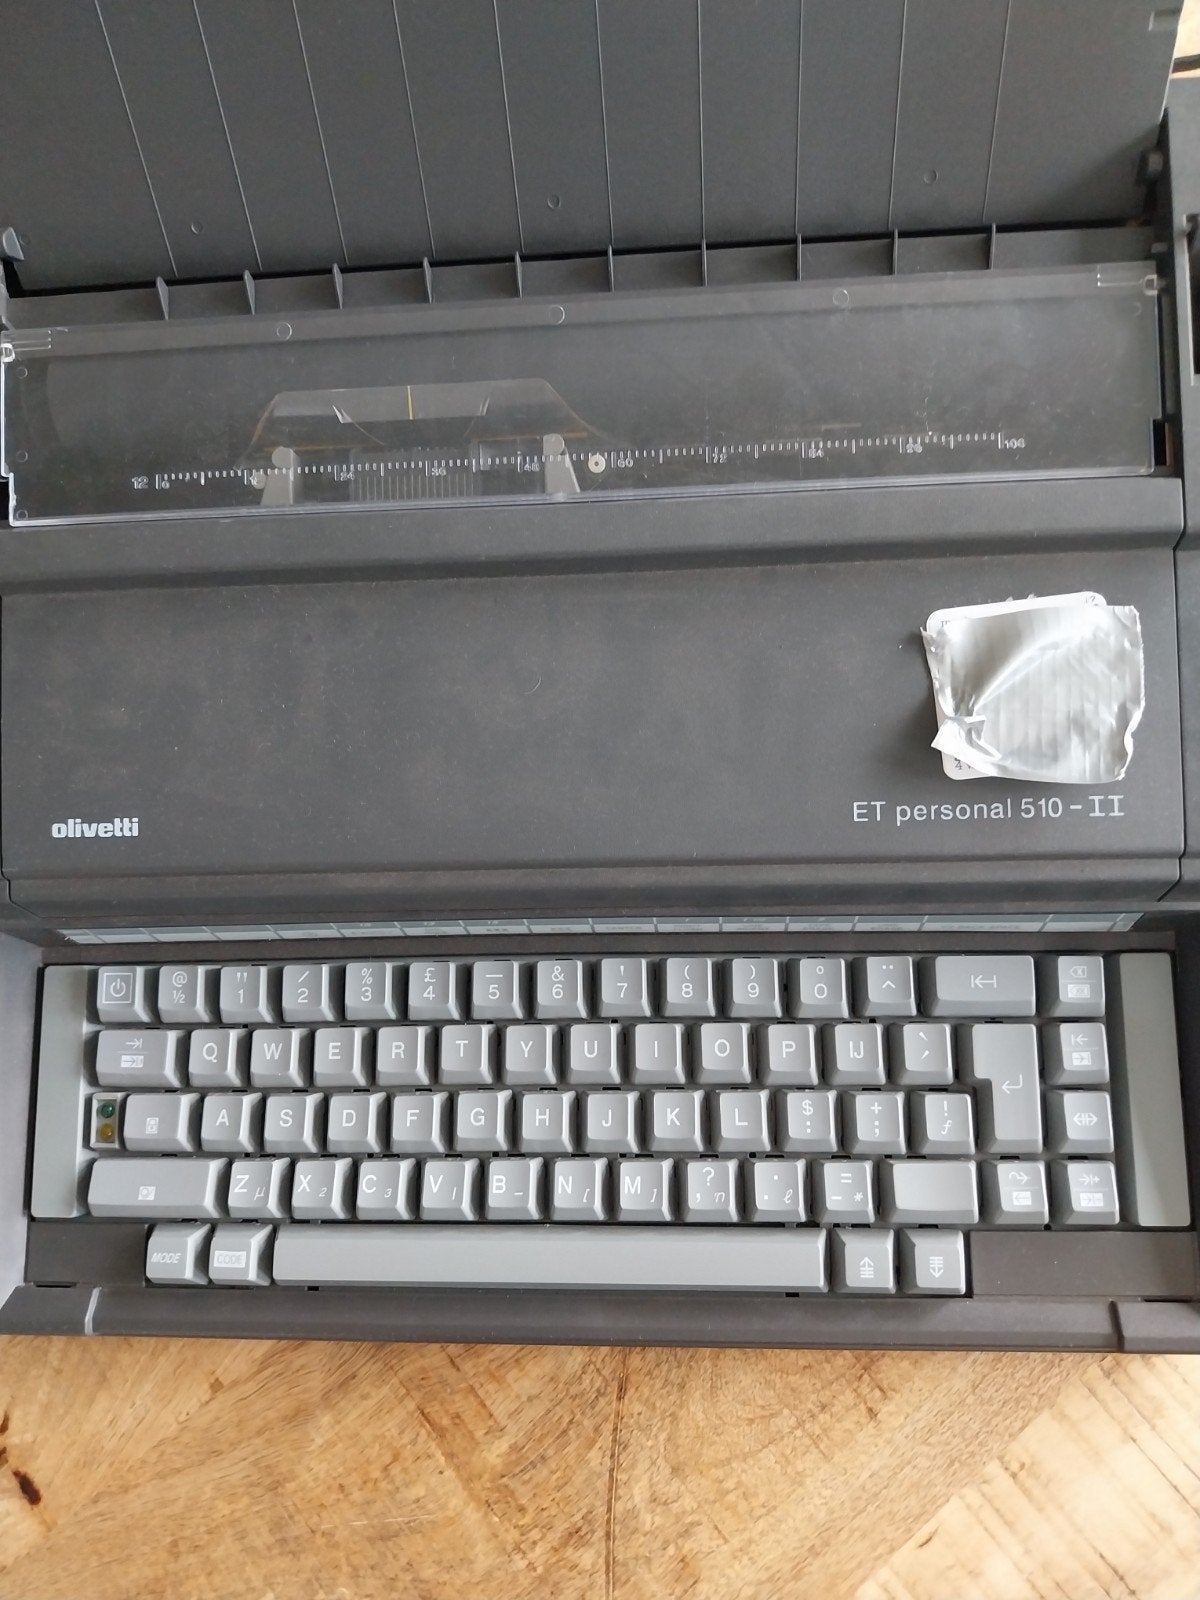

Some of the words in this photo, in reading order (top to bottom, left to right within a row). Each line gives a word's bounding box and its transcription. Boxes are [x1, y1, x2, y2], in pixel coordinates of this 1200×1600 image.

[131, 475, 149, 489] 12
[853, 801, 886, 822] ET
[896, 798, 1012, 826] personal
[1020, 797, 1063, 818] 510
[51, 817, 139, 838] olivetti
[172, 971, 188, 987] @
[361, 968, 373, 984] %
[424, 968, 436, 983] £
[551, 966, 565, 981] &
[684, 965, 690, 980] (
[749, 965, 756, 980] )
[238, 989, 245, 1004] 1
[297, 988, 309, 1004] 2
[360, 987, 372, 1002] 3
[423, 986, 436, 1000] 4
[488, 985, 500, 1000] 5
[551, 984, 564, 999] 6
[616, 983, 628, 998] 7
[681, 983, 693, 998] 8
[747, 983, 760, 998] 9
[814, 984, 828, 999] 0
[202, 1042, 218, 1063] Q
[263, 1043, 282, 1060] W
[328, 1042, 341, 1060] E
[391, 1042, 405, 1059] R
[455, 1040, 469, 1058] T
[520, 1040, 533, 1058] Y
[583, 1040, 598, 1058] U
[714, 1039, 730, 1057] O
[782, 1041, 796, 1059] P
[802, 1099, 814, 1116] $
[870, 1102, 882, 1114] +
[215, 1109, 230, 1126] A
[279, 1109, 293, 1128] S
[342, 1109, 356, 1127] D
[406, 1109, 420, 1127] F
[470, 1107, 485, 1126] G
[535, 1108, 550, 1127] H
[601, 1109, 612, 1127] J
[666, 1107, 680, 1126] K
[734, 1108, 748, 1126] L
[233, 1174, 250, 1193] Z
[297, 1174, 312, 1192] X
[362, 1174, 377, 1193] C
[429, 1174, 444, 1193] V
[491, 1175, 507, 1194] B
[558, 1175, 573, 1194] N
[702, 1166, 715, 1186] ?
[840, 1173, 852, 1183] =
[624, 1175, 641, 1195] M
[150, 1252, 182, 1264] MODE
[216, 1254, 244, 1265] CODE
